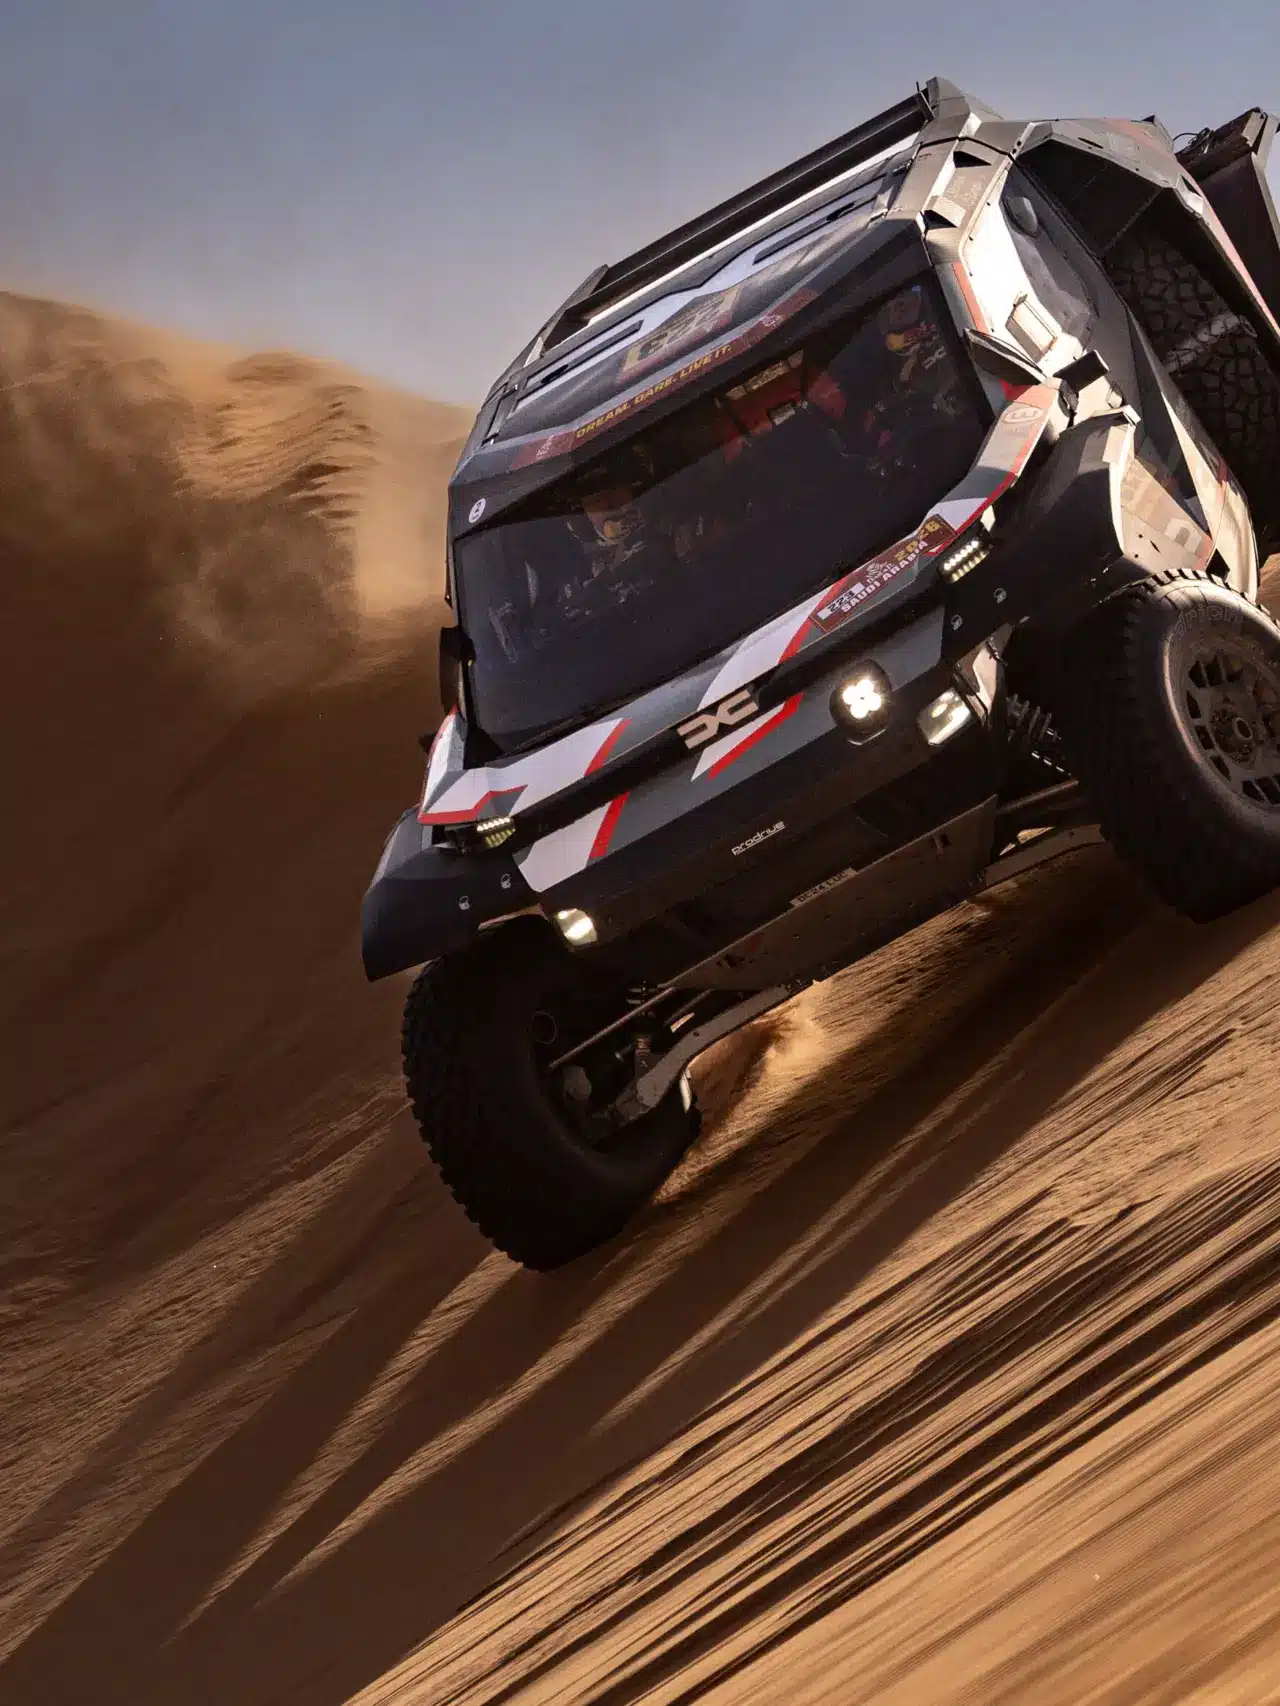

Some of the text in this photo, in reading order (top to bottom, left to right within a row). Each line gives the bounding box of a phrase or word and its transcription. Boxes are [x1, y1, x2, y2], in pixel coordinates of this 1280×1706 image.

[576, 403, 632, 438] DREAM.
[634, 375, 677, 404] DARE.
[680, 355, 712, 378] LIVE
[827, 590, 855, 612] 223
[895, 520, 941, 561] 2026
[841, 540, 929, 613] SAUDI ARABIA
[731, 821, 786, 856] prodrive
